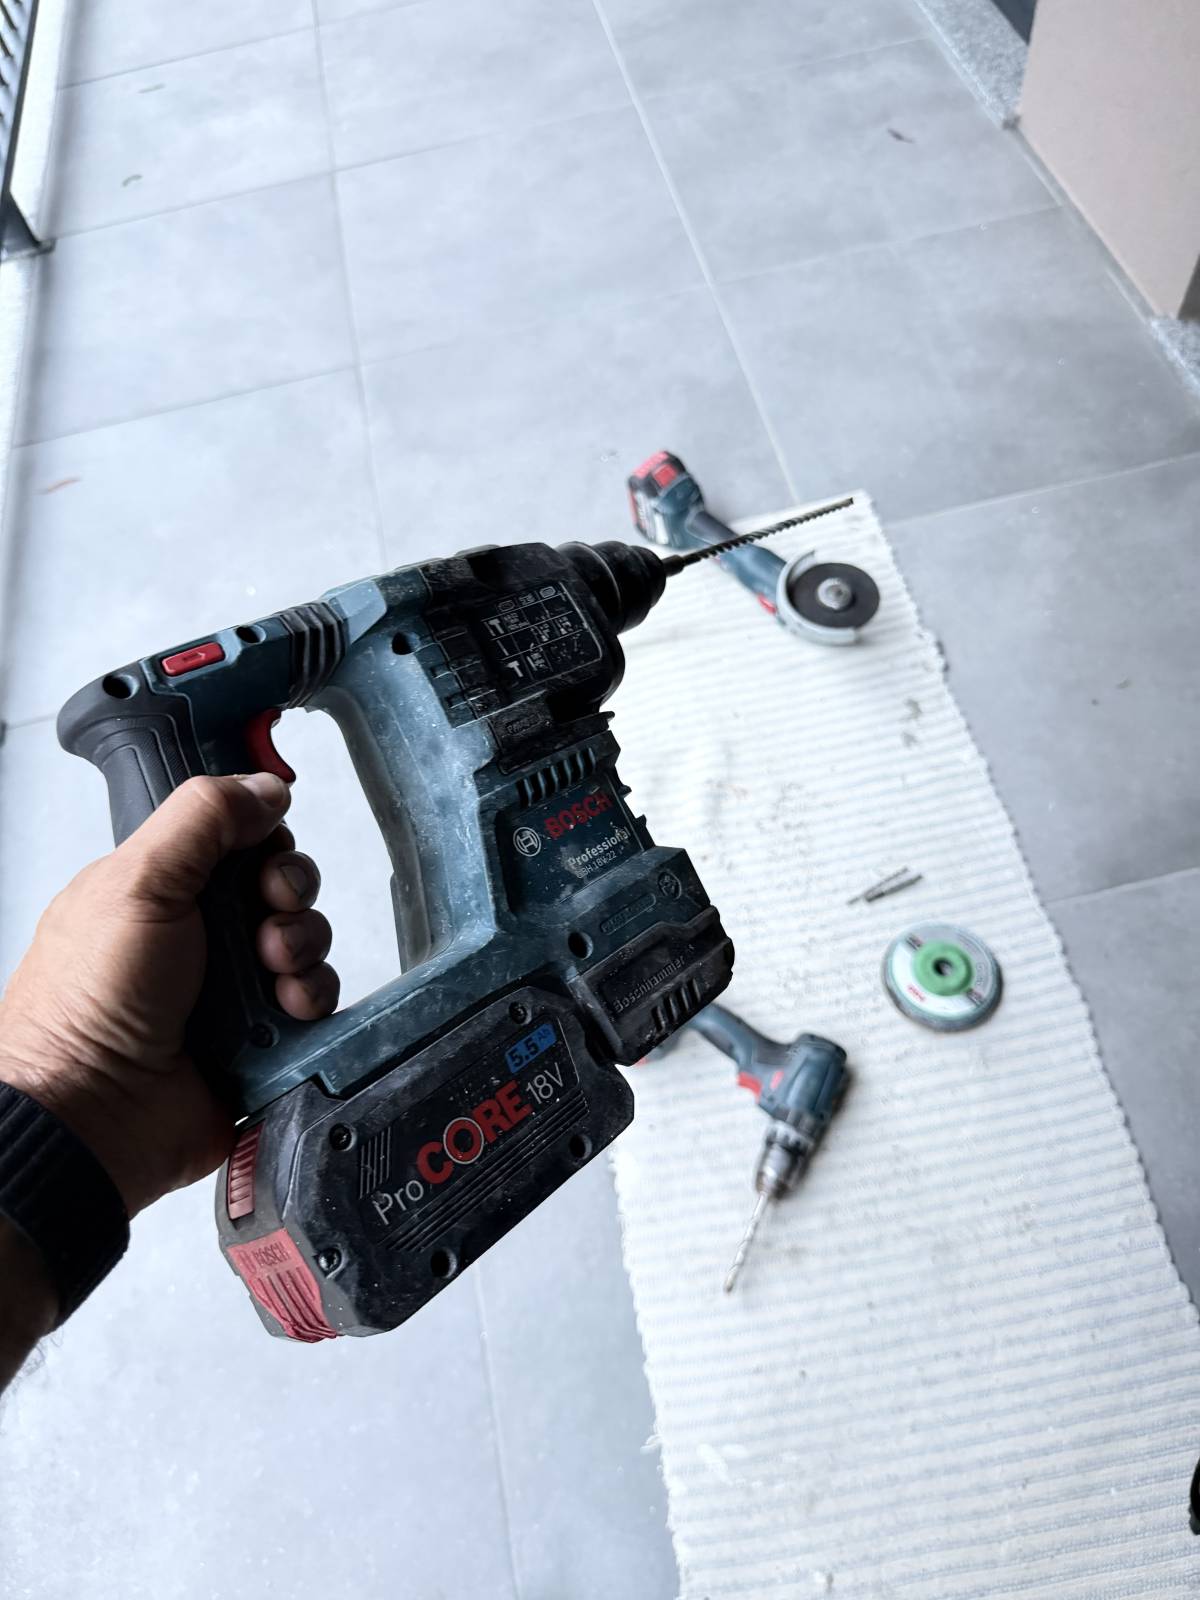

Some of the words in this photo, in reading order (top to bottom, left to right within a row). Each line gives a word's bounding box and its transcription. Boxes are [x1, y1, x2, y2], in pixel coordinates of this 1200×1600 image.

[544, 792, 614, 840] BOSCH
[567, 827, 631, 867] Professional
[509, 1037, 540, 1068] 5.5
[526, 1062, 565, 1105] 18V
